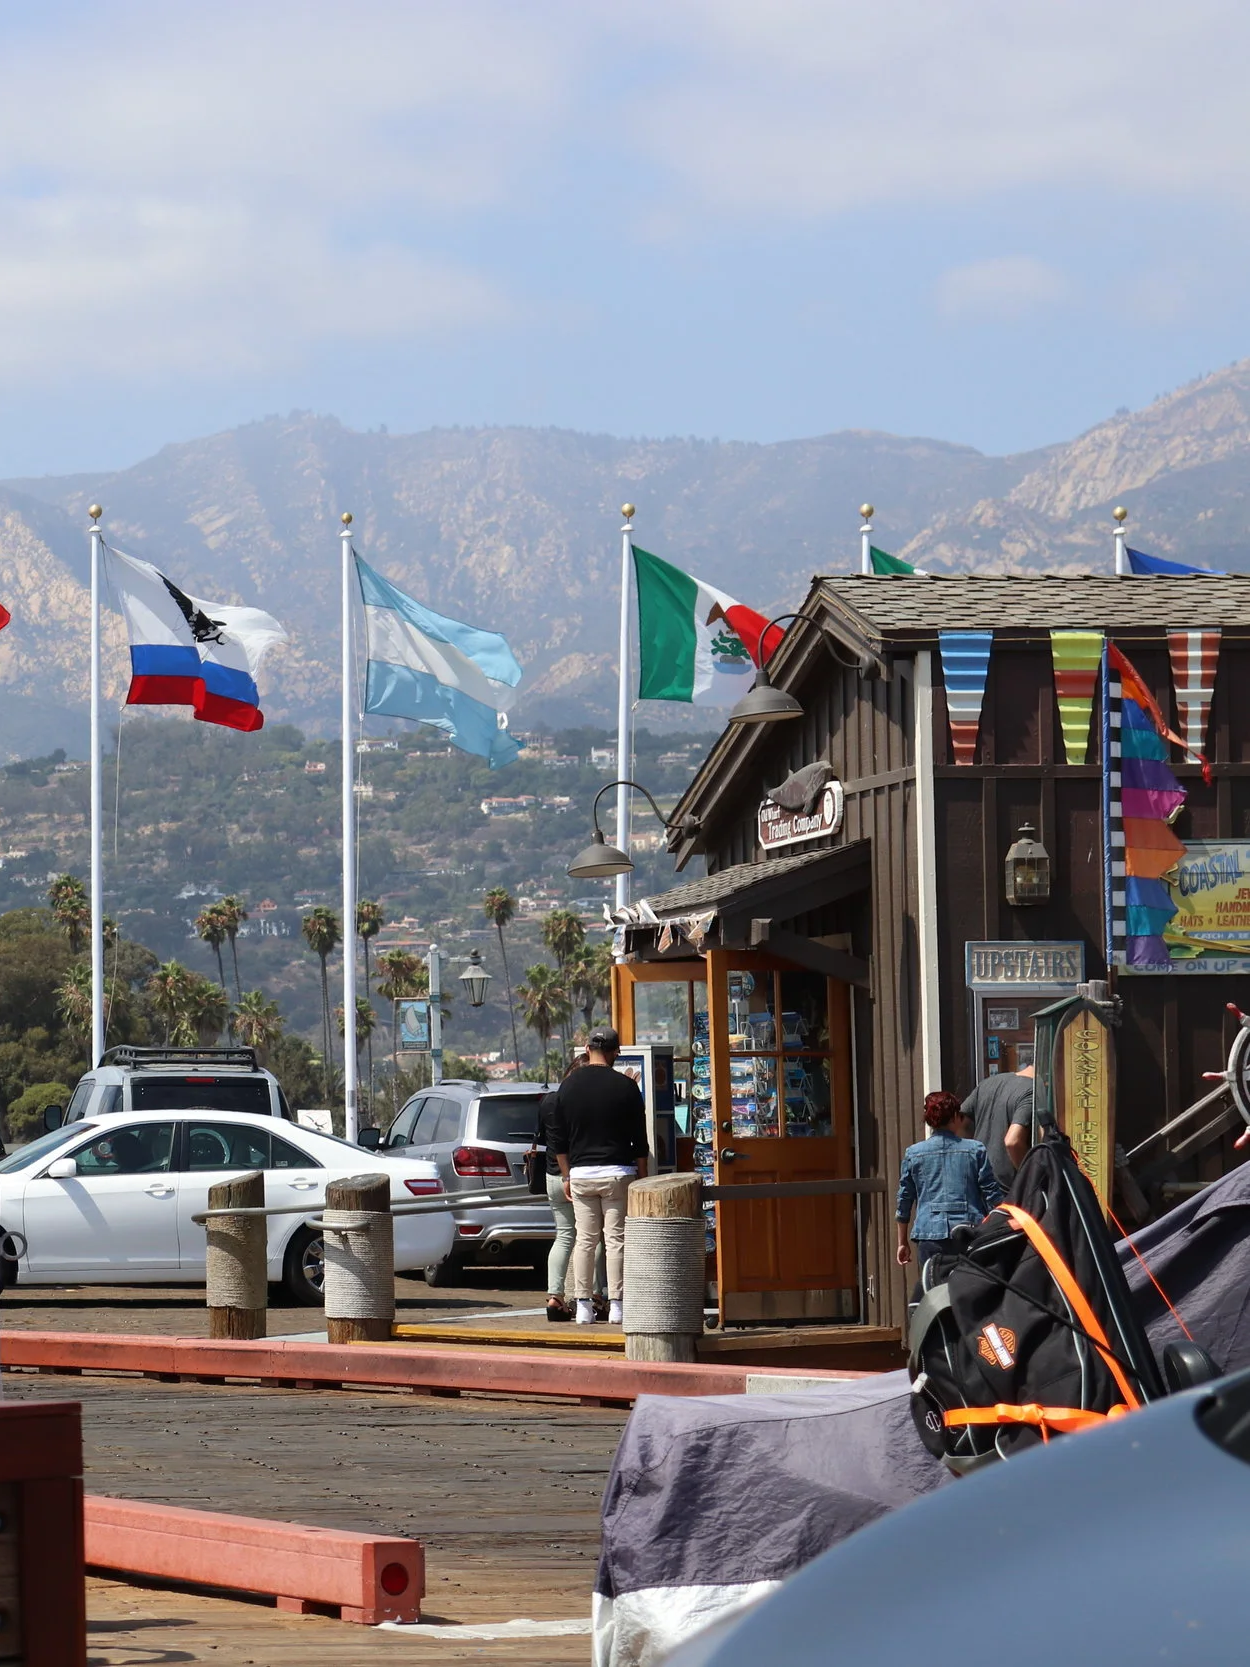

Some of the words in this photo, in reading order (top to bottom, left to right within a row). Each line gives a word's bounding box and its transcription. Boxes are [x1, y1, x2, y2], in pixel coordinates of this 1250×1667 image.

[768, 820, 792, 840] Trading
[793, 813, 823, 838] Company
[1179, 849, 1244, 897] COASTAL
[1235, 888, 1250, 899] JE
[1180, 915, 1204, 927] HATS
[972, 949, 1078, 979] UPSTAIRS
[1134, 960, 1179, 972] COME
[1185, 960, 1208, 971] ON
[1213, 960, 1239, 972] UP
[1073, 1029, 1100, 1109] COASTAL
[1073, 1120, 1100, 1186] TREAS
